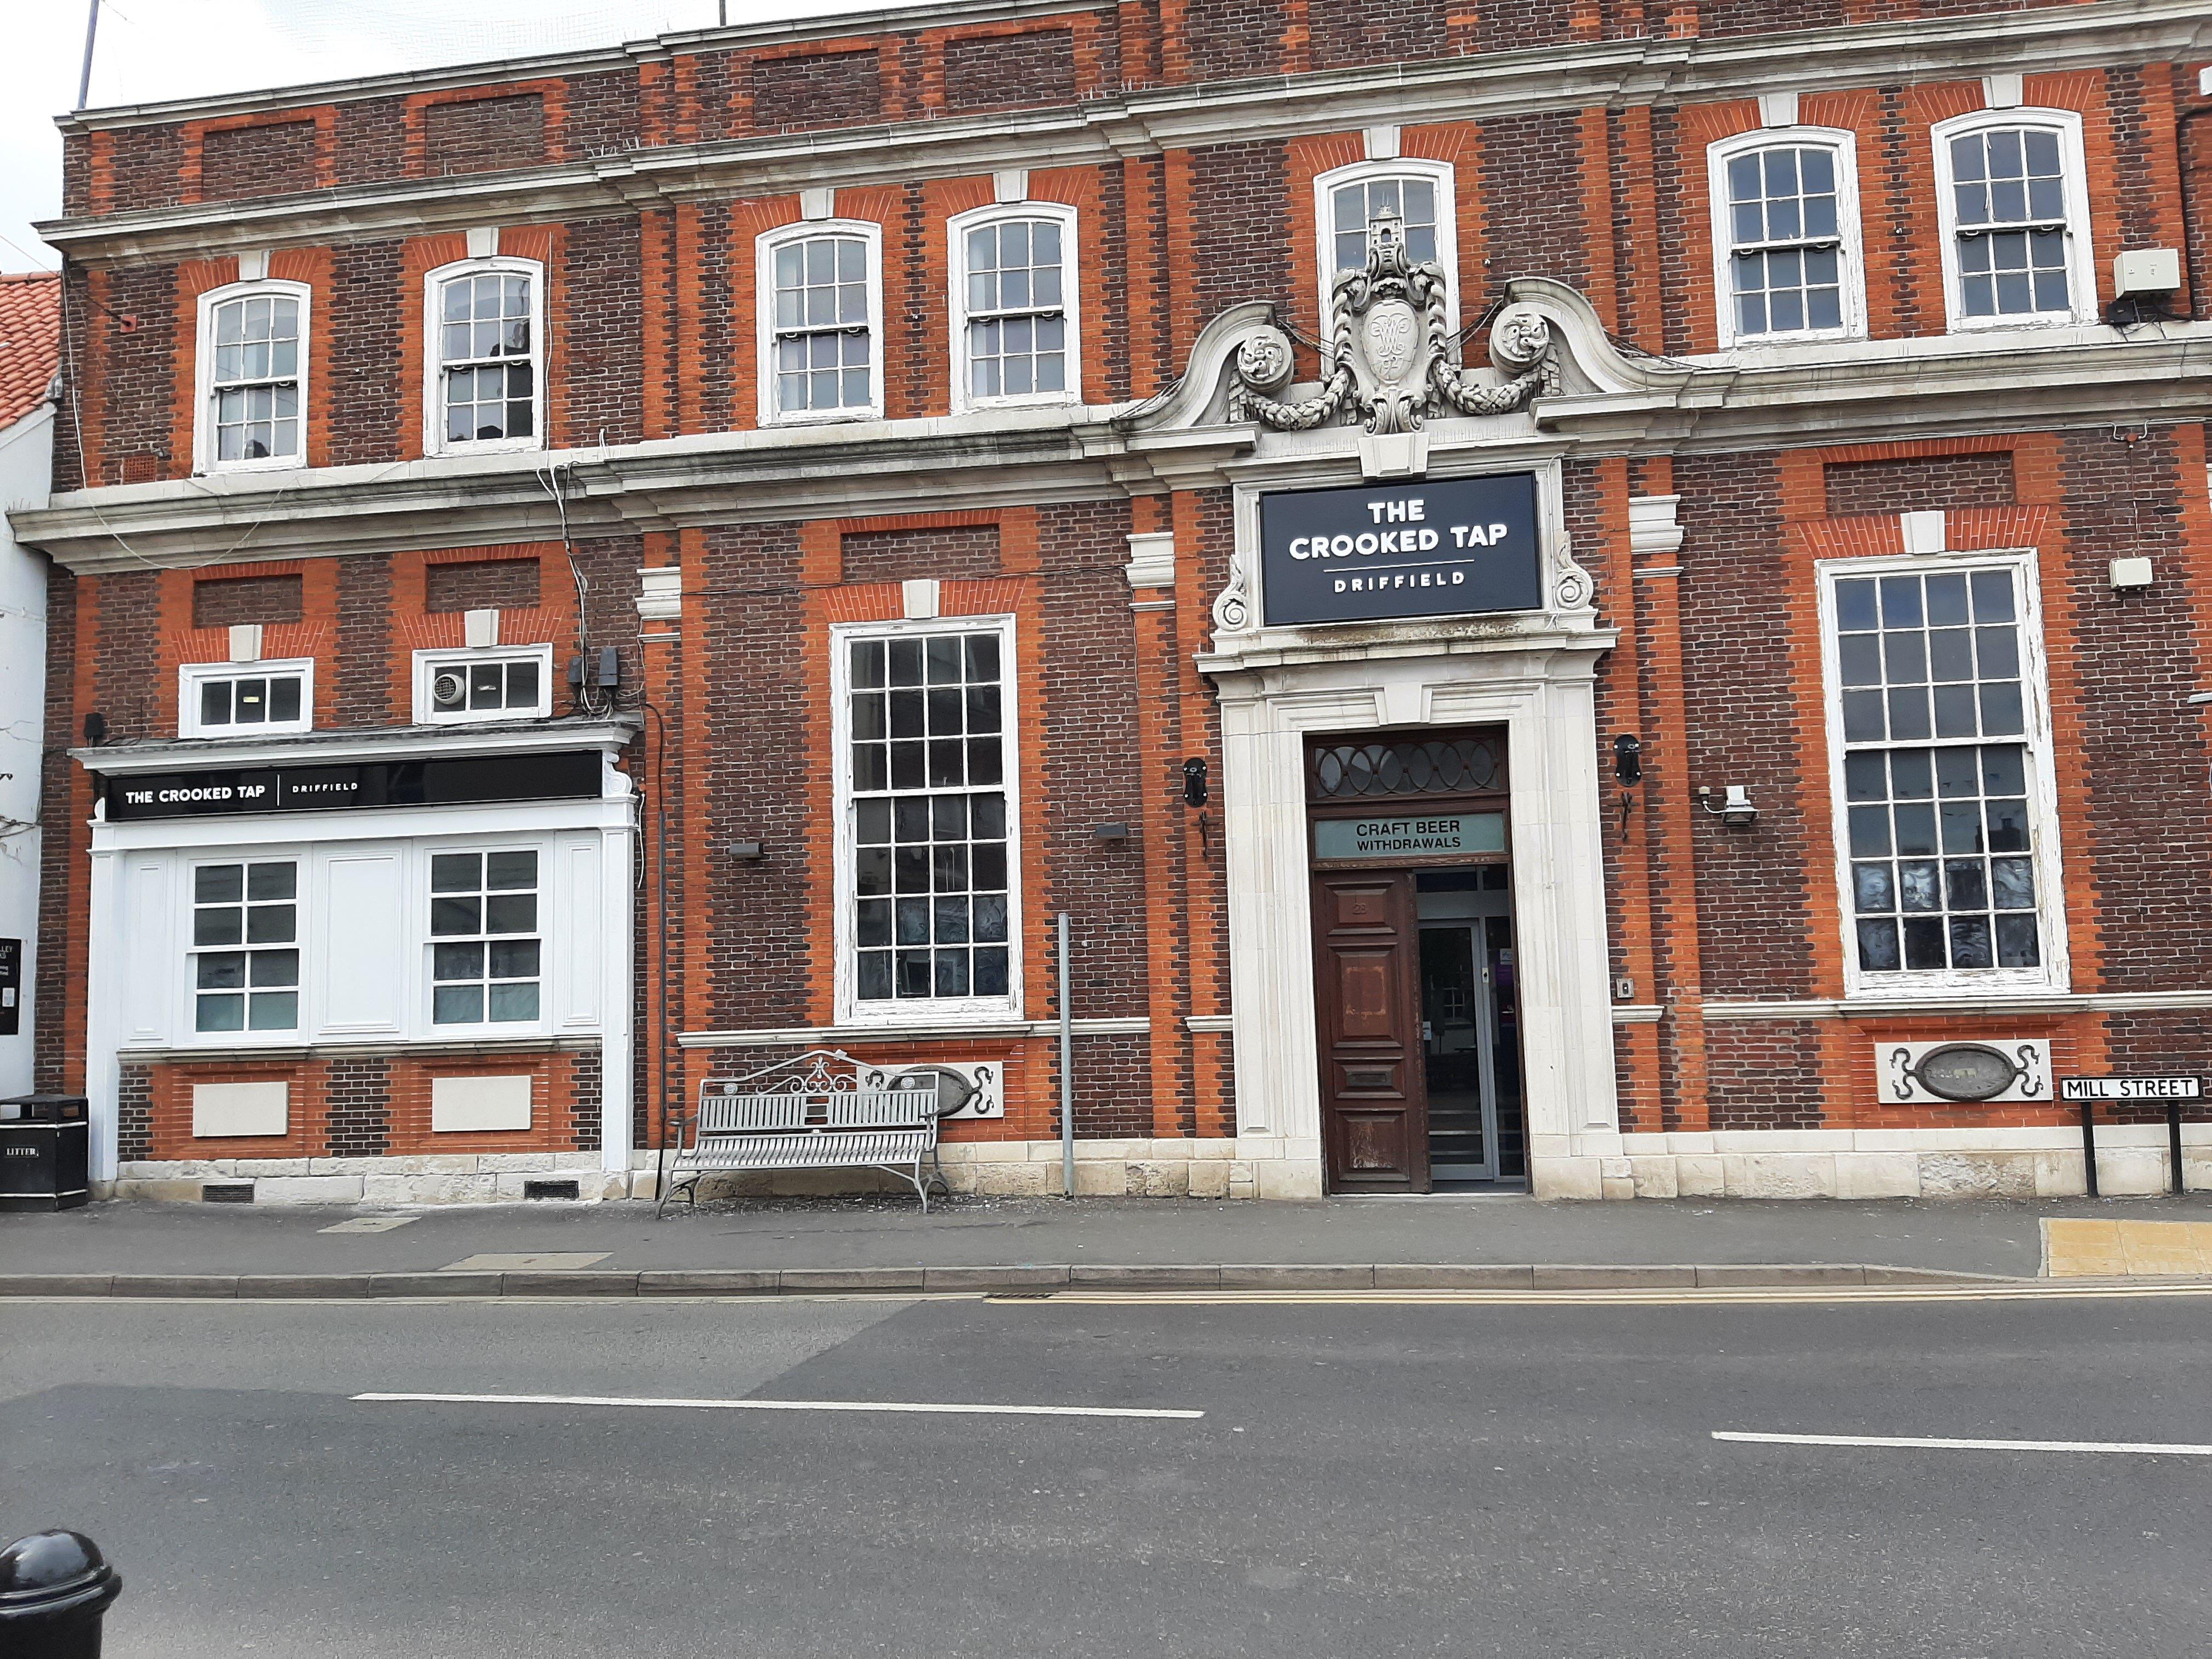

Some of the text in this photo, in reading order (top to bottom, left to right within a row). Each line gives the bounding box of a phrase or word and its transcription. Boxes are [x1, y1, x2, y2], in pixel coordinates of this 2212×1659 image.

[1367, 499, 1425, 524] THE
[1289, 524, 1507, 560] CROOKED TAP
[1334, 572, 1465, 592] DRIFFIELD
[126, 782, 358, 804] THE CROOKED TAP DRIFFIELD
[1356, 820, 1460, 837] CRAFT BEER
[1357, 837, 1461, 851] WITHDRAWALS
[2067, 1080, 2192, 1097] MILL STREET
[7, 1148, 36, 1156] LITTER
